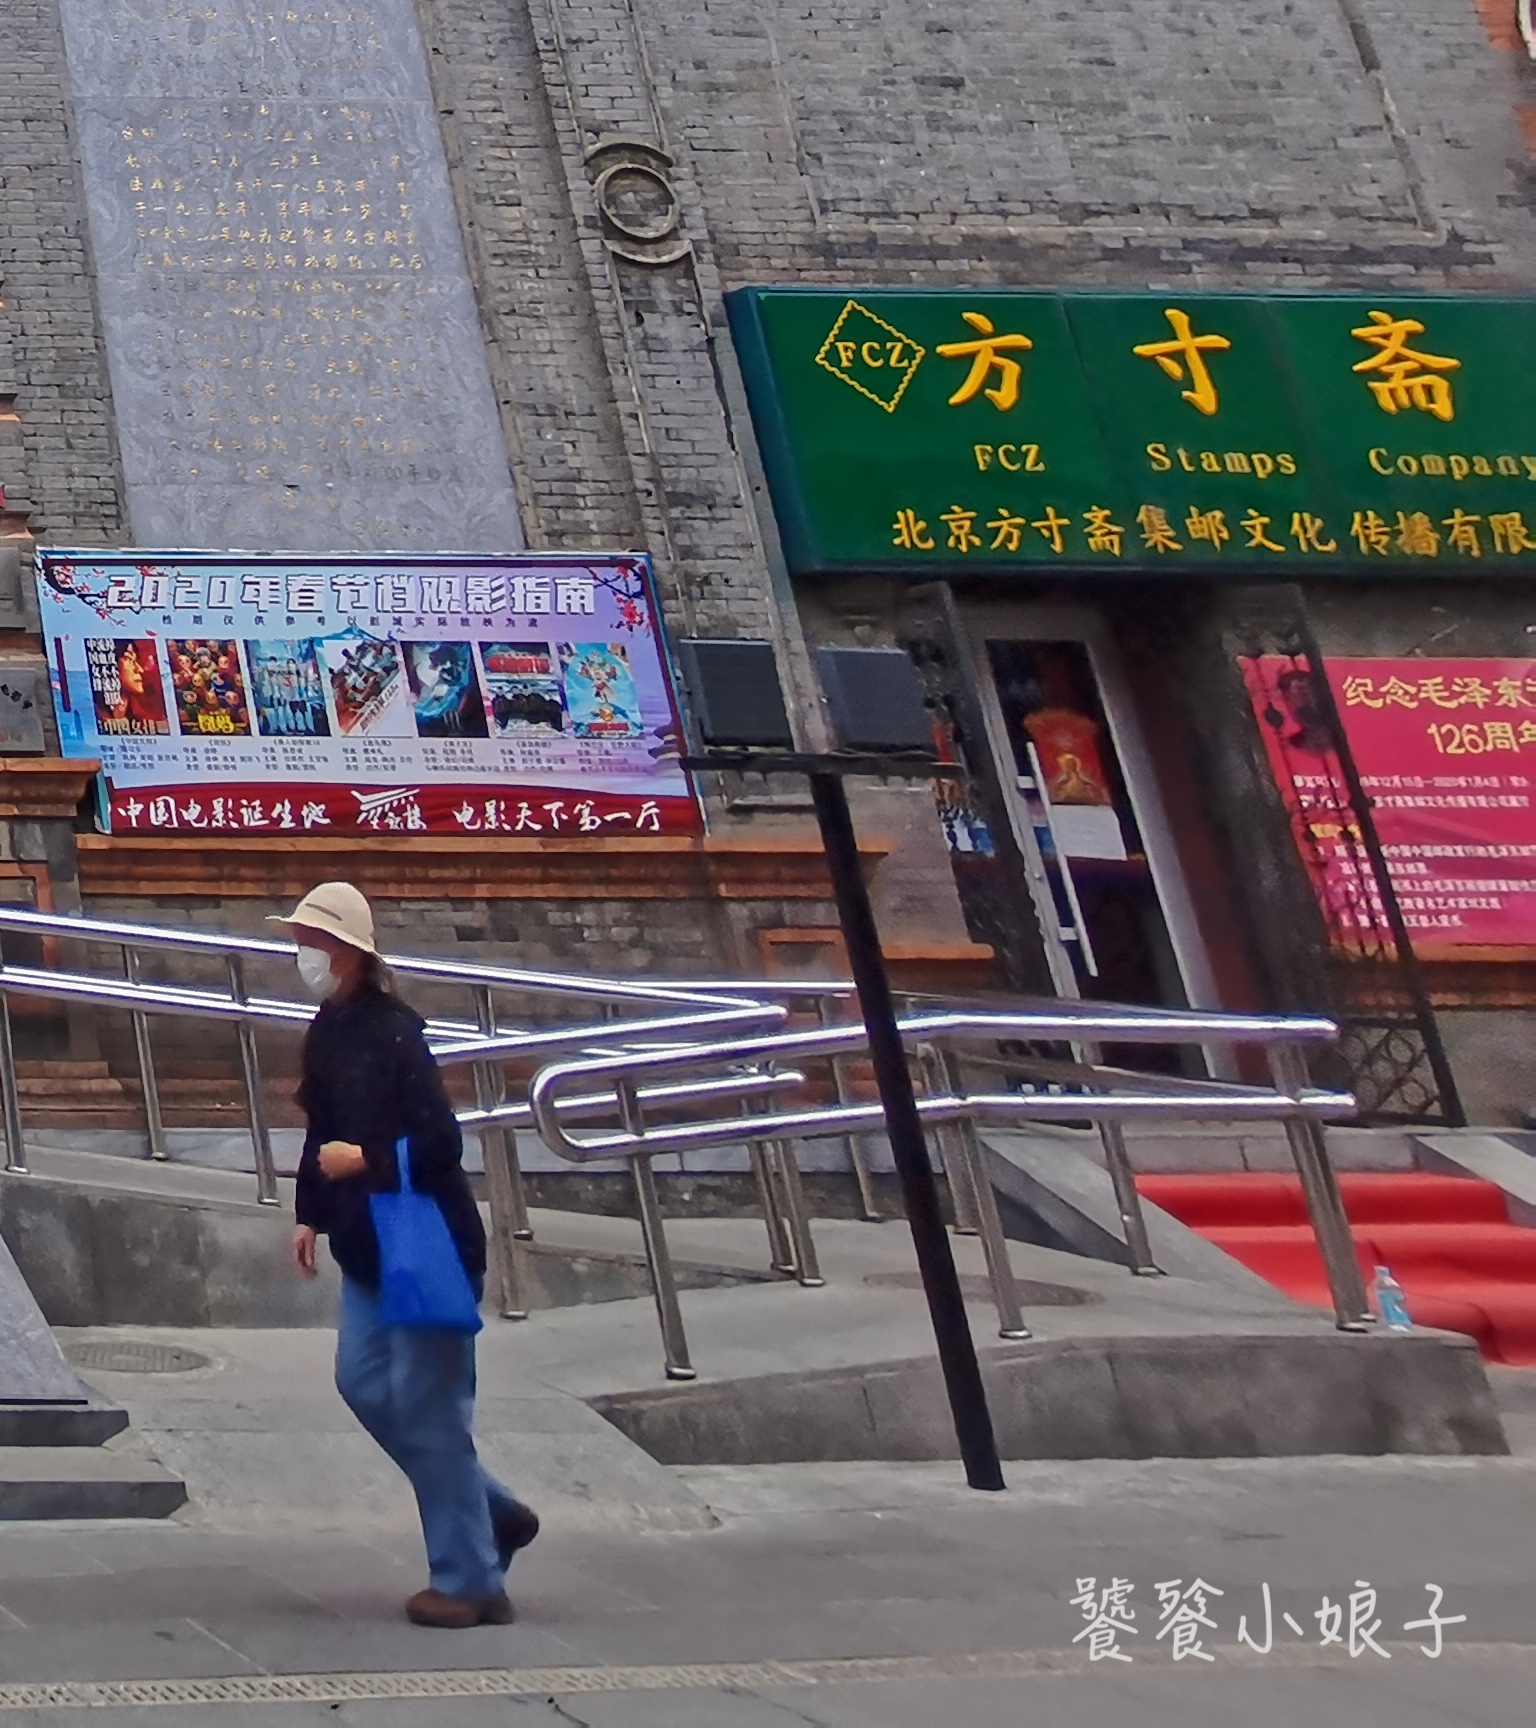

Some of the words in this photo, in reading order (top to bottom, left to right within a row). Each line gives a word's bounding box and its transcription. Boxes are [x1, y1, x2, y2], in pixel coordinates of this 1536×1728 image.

[835, 341, 910, 369] FCZ
[936, 309, 1462, 422] 方寸斋
[974, 444, 1046, 472] FCZ
[1147, 442, 1296, 479] Stamps
[106, 574, 596, 614] 2020年春节档观影指南
[118, 795, 331, 829] 中国电影诞生地
[453, 800, 661, 832] 电影天下第一厅
